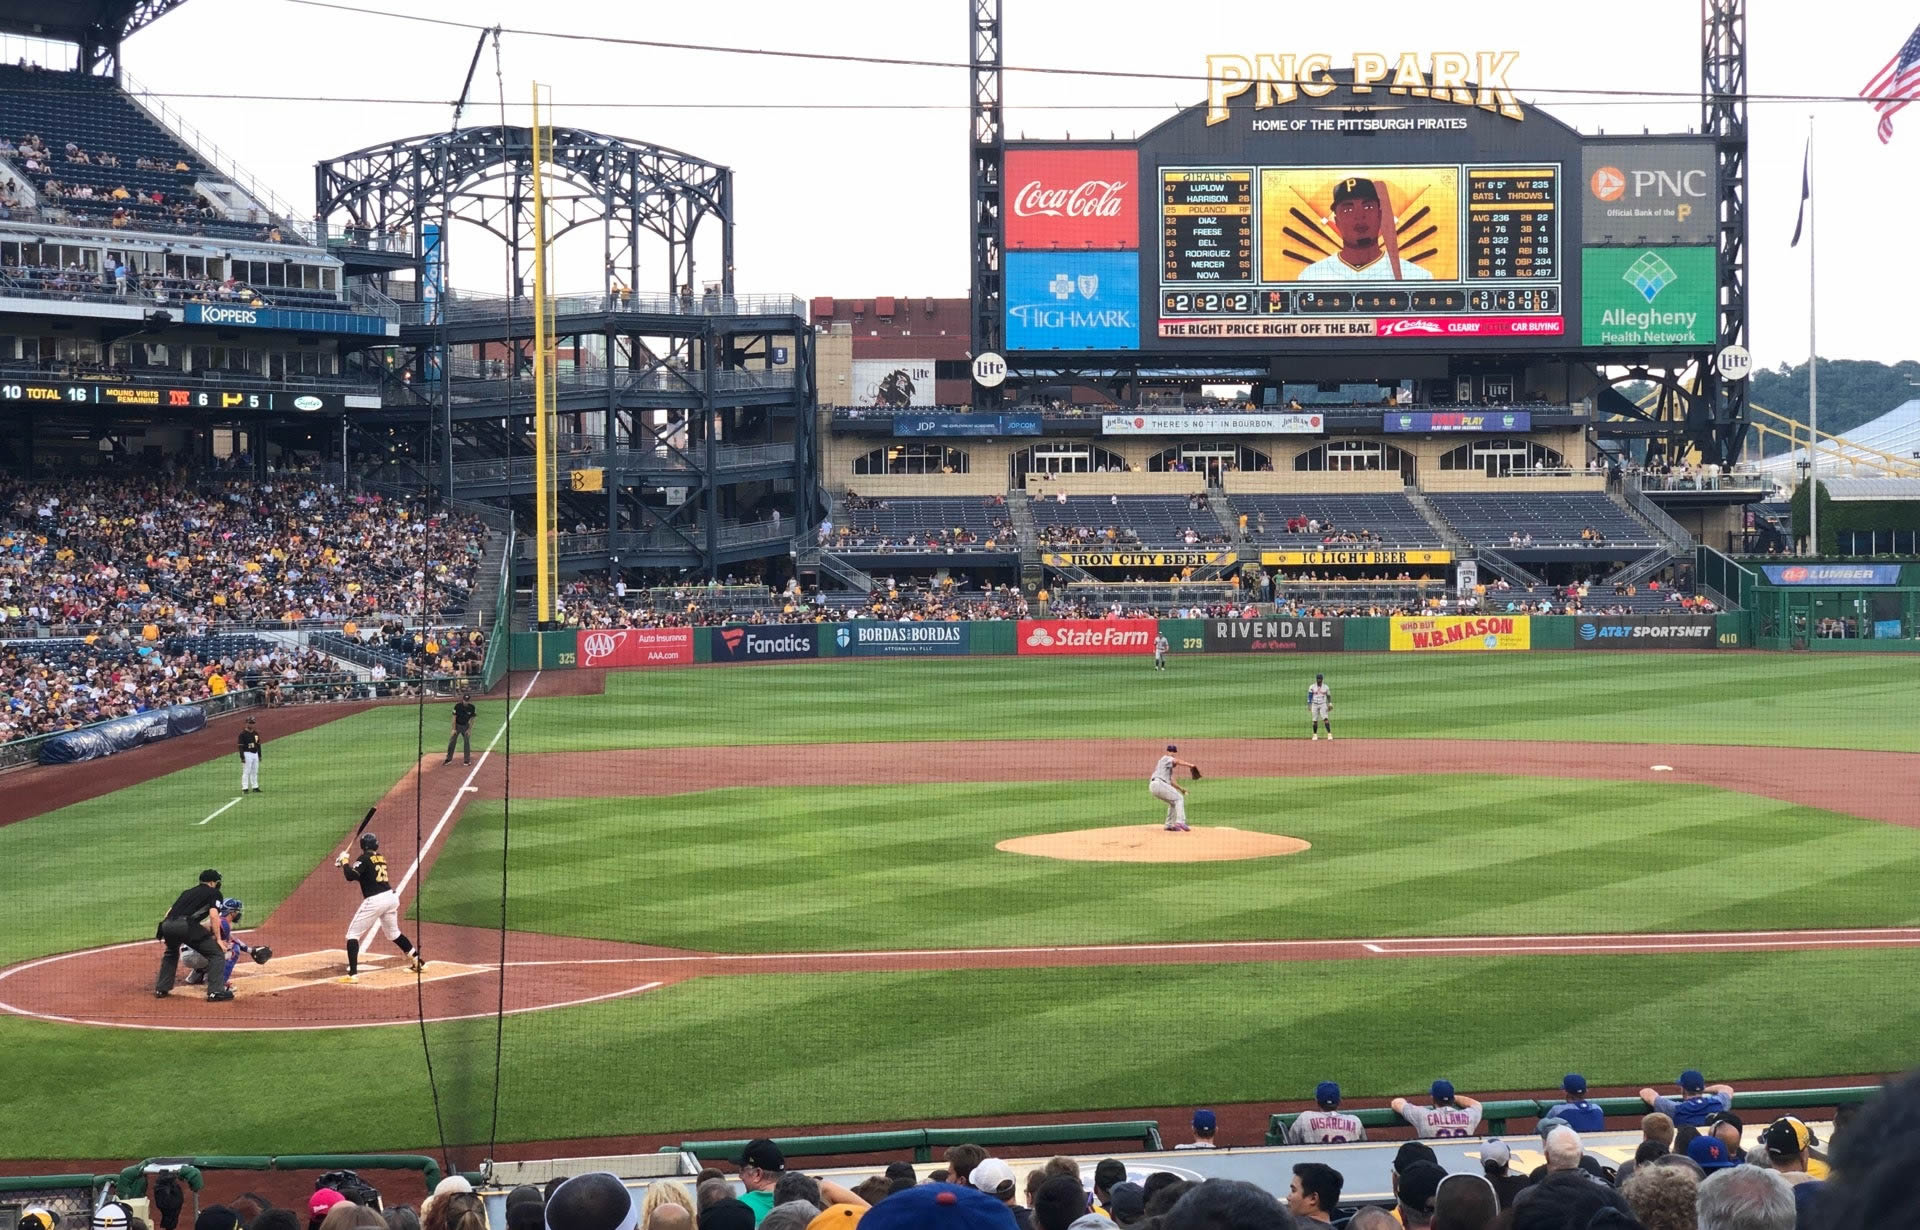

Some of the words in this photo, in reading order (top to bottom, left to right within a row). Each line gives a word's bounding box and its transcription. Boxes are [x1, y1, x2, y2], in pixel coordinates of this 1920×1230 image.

[1206, 54, 1338, 127] PNC
[1353, 51, 1524, 121] PARK
[1253, 120, 1288, 131] HOME
[1290, 120, 1306, 131] OF
[1310, 120, 1335, 131] THE
[1337, 119, 1414, 131] PITTSBURGH
[1418, 118, 1467, 130] PIRATES
[1631, 170, 1707, 197] PNC
[1014, 181, 1128, 217] Coca-Cola
[1607, 209, 1632, 217] Official
[1635, 209, 1652, 217] Bank
[1167, 299, 1175, 308] B
[1176, 295, 1189, 311] 2
[1197, 299, 1204, 308] S
[1206, 295, 1218, 311] 2
[1235, 295, 1247, 311] 2
[202, 306, 256, 324] KOPPERS
[1011, 305, 1131, 329] HIGHMARK
[1601, 309, 1697, 328] Allegheny
[1164, 325, 1185, 334] THE
[1189, 325, 1222, 335] RIGHT
[1227, 325, 1260, 335] PRICE
[1263, 324, 1297, 334] RIGHT
[1301, 324, 1321, 334] OFF
[1326, 324, 1346, 334] THE
[1349, 324, 1373, 334] BAT.
[1448, 323, 1480, 331] CLEARLY
[1512, 323, 1528, 331] CAR
[1529, 323, 1560, 331] BUYING
[1601, 331, 1641, 342] Health
[1644, 331, 1696, 342] Network
[1721, 353, 1749, 371] Lite
[977, 361, 1003, 377] Lite
[911, 369, 930, 381] Lite
[3, 386, 21, 398] 10
[26, 388, 61, 400] TOTAL
[68, 388, 86, 401] 16
[106, 389, 134, 397] MOUND
[136, 390, 159, 398] VISITS
[1490, 385, 1508, 397] Lite
[117, 396, 159, 404] REMAINING
[199, 394, 208, 405] 6
[250, 396, 259, 407] 5
[916, 422, 936, 431] JDP
[1462, 417, 1484, 425] PLAY
[1072, 555, 1113, 565] IRON
[1119, 555, 1157, 565] CITY
[1164, 554, 1208, 565] BEER
[1303, 554, 1316, 564] IC
[1321, 553, 1369, 564] LIGHT
[1374, 553, 1407, 563] BEER
[1810, 570, 1874, 579] LUMBER
[1217, 622, 1332, 638] RIVENDALE
[1401, 623, 1418, 631] WHO
[1420, 621, 1435, 630] BUT
[1599, 626, 1632, 637] AT&T
[1633, 626, 1711, 637] SPORTSNET
[639, 635, 655, 643] Auto
[657, 634, 687, 642] Insurance
[859, 628, 906, 641] BORDAS
[912, 627, 960, 641] BORDAS
[1720, 634, 1737, 644] 410
[587, 635, 612, 655] AAA
[747, 634, 811, 653] Fanatics
[1184, 638, 1202, 649] 379
[1268, 640, 1296, 649] Cream
[559, 653, 575, 664] 325
[648, 652, 678, 660] AAA.com
[376, 865, 388, 882] 25
